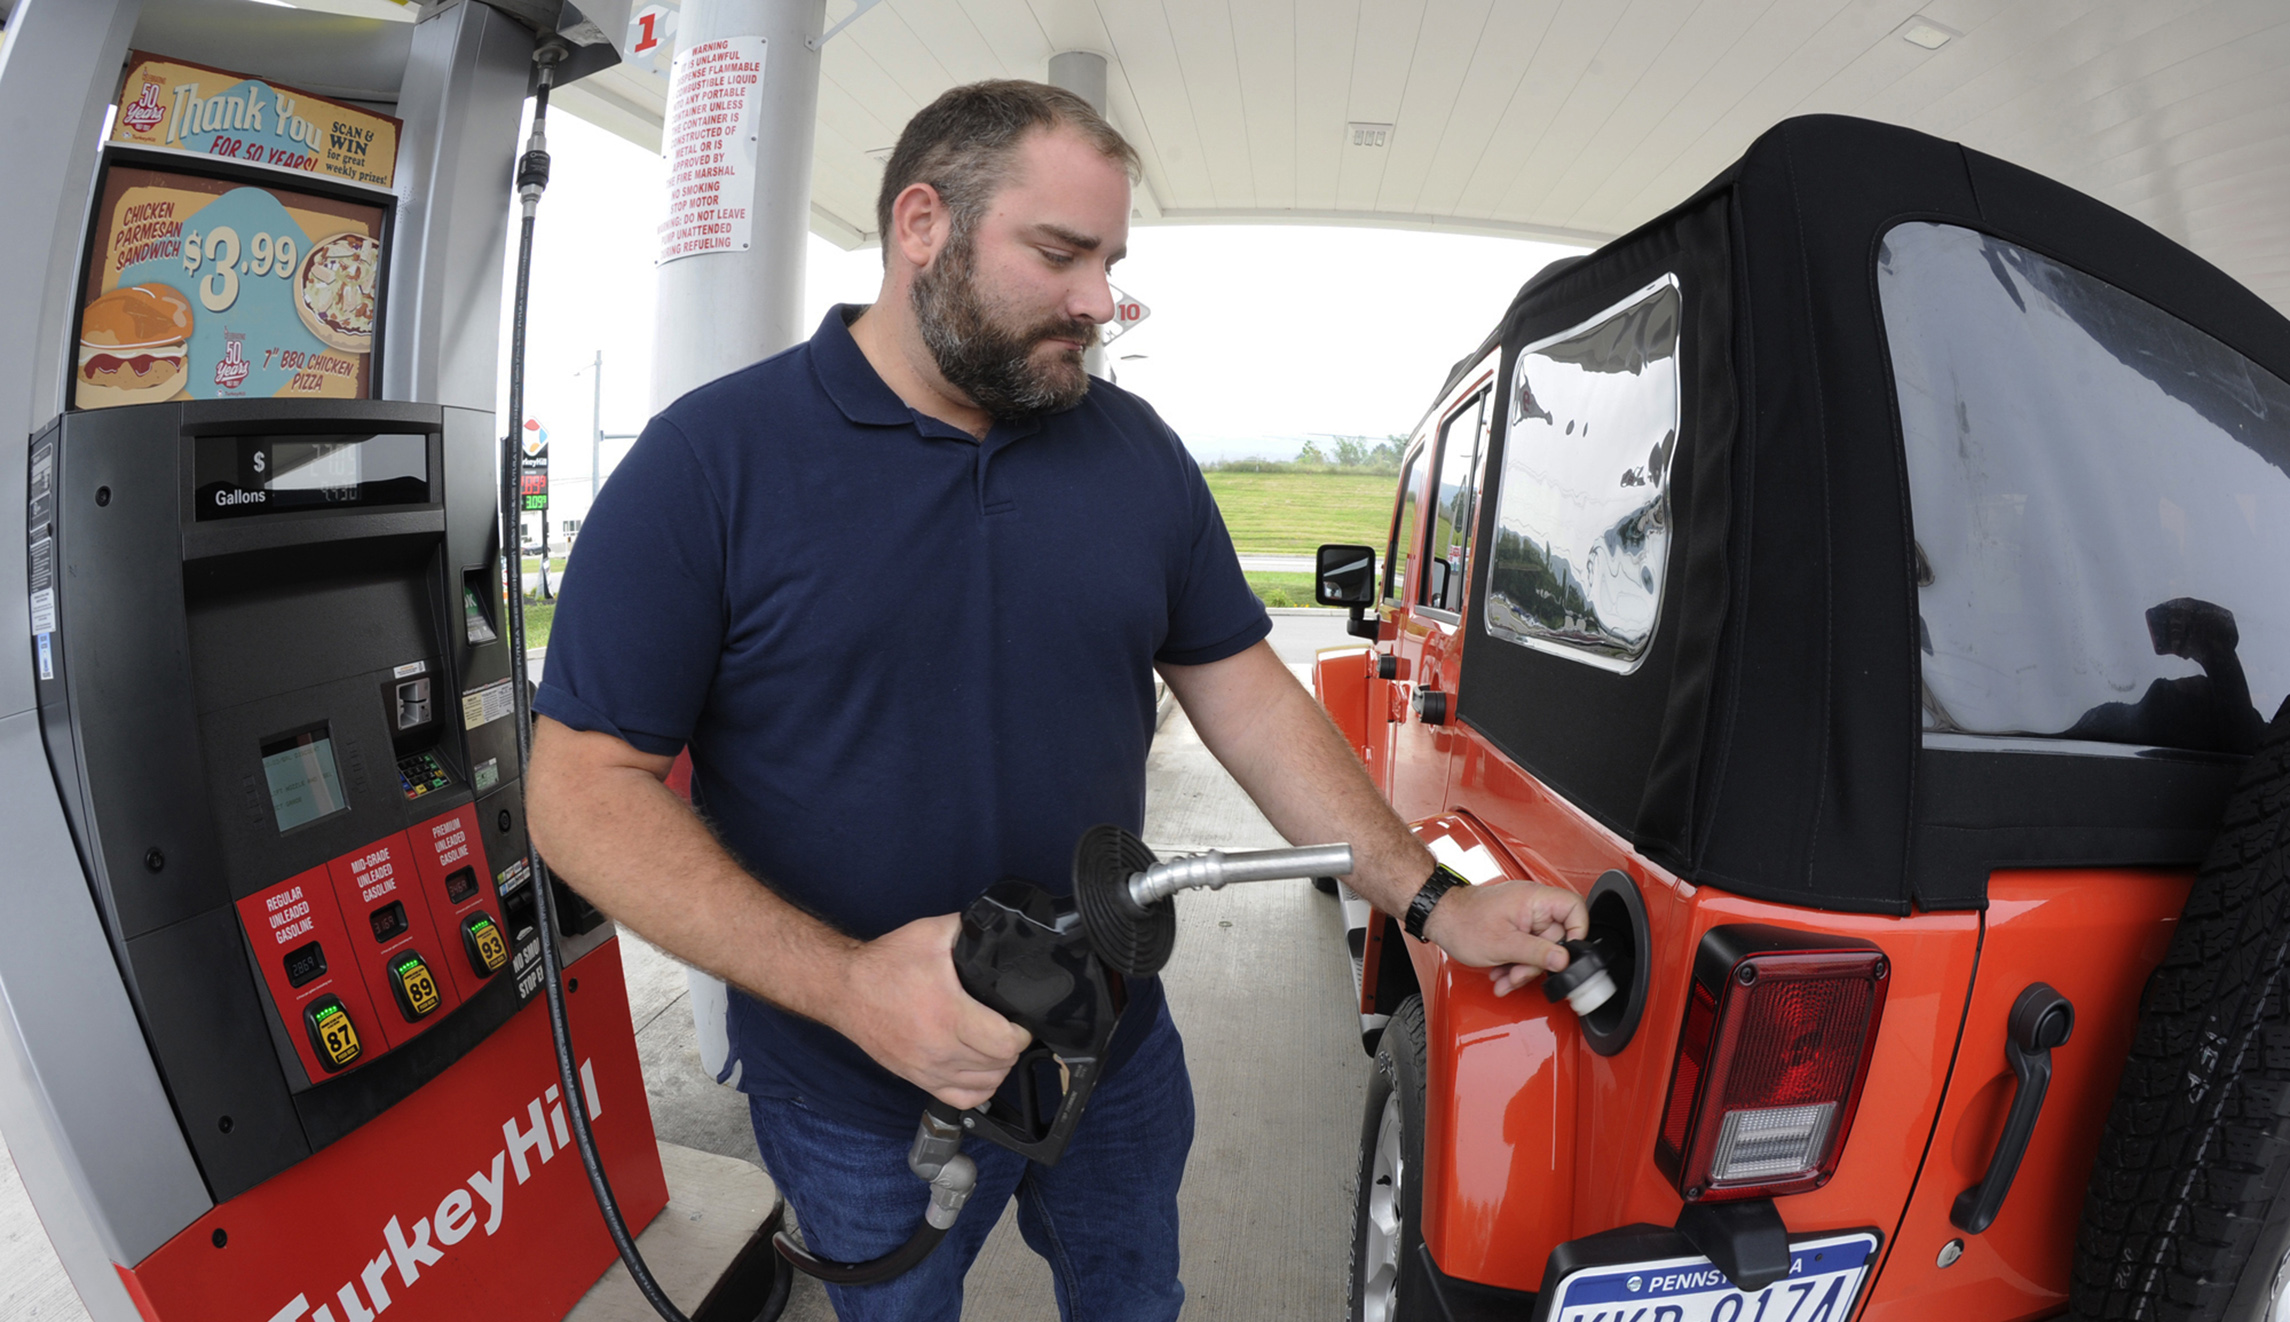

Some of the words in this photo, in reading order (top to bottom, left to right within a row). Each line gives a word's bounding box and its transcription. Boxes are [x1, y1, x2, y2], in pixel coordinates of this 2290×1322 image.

[634, 13, 658, 53] 1
[692, 40, 728, 56] WARNING
[696, 51, 740, 66] UNLAWFUL
[708, 62, 760, 76] FLAMMABLE
[727, 74, 757, 85] LIQUID
[139, 82, 160, 108] 50
[685, 92, 700, 105] ANY
[702, 87, 746, 100] PORTABLE
[709, 99, 744, 112] UNLESS
[123, 103, 165, 123] Years
[165, 82, 266, 145] Thank
[275, 92, 322, 153] You
[683, 113, 728, 131] CONTAINER
[731, 112, 739, 122] IS
[332, 121, 362, 138] SCAN
[365, 130, 374, 142] &
[725, 125, 737, 136] OF
[209, 135, 242, 158] FOR
[243, 143, 264, 162] 50
[268, 147, 318, 172] YEARS!
[330, 134, 368, 156] WIN
[675, 144, 697, 159] METAL
[700, 141, 712, 152] OR
[714, 139, 723, 150] IS
[327, 148, 341, 161] for
[342, 154, 365, 168] great
[673, 154, 711, 172] APPROVED
[713, 152, 725, 163] BY
[325, 163, 357, 179] weekly
[359, 171, 387, 185] prizes!
[676, 171, 693, 184] FIRE
[694, 165, 735, 179] MARSHAL
[682, 181, 720, 197] SMOKING
[123, 202, 175, 227] CHICKEN
[670, 200, 688, 214] STOP
[689, 195, 719, 209] MOTOR
[684, 213, 695, 224] DO
[697, 209, 715, 222] NOT
[717, 208, 746, 219] LEAVE
[114, 222, 183, 251] PARMESAN
[677, 222, 732, 240] UNATTENDED
[116, 240, 181, 271] SANDWICH
[683, 237, 731, 252] REFUELING
[1118, 303, 1141, 321] 10
[226, 341, 242, 364] 50
[280, 350, 305, 370] BBQ
[307, 354, 354, 377] CHICKEN
[215, 361, 250, 381] Years
[291, 372, 323, 391] PIZZA
[253, 451, 265, 473] $
[215, 490, 266, 506] Gallons
[432, 818, 461, 838] PREMIUM
[435, 831, 466, 853] UNLEADED
[351, 848, 391, 874] MID-GRADE
[440, 844, 469, 866] GASOLINE
[357, 863, 393, 888] UNLEADED
[266, 886, 303, 912] REGULAR
[362, 878, 397, 902] GASOLINE
[269, 901, 310, 929] UNLEADED
[275, 917, 314, 945] GASOLINE
[481, 937, 501, 959] 93
[512, 955, 524, 974] NO
[410, 978, 433, 1003] 89
[518, 973, 538, 999] STOP
[327, 1024, 351, 1053] 87
[267, 1057, 602, 1322] urkeyHil
[1648, 1258, 1802, 1292] PENNSYA
